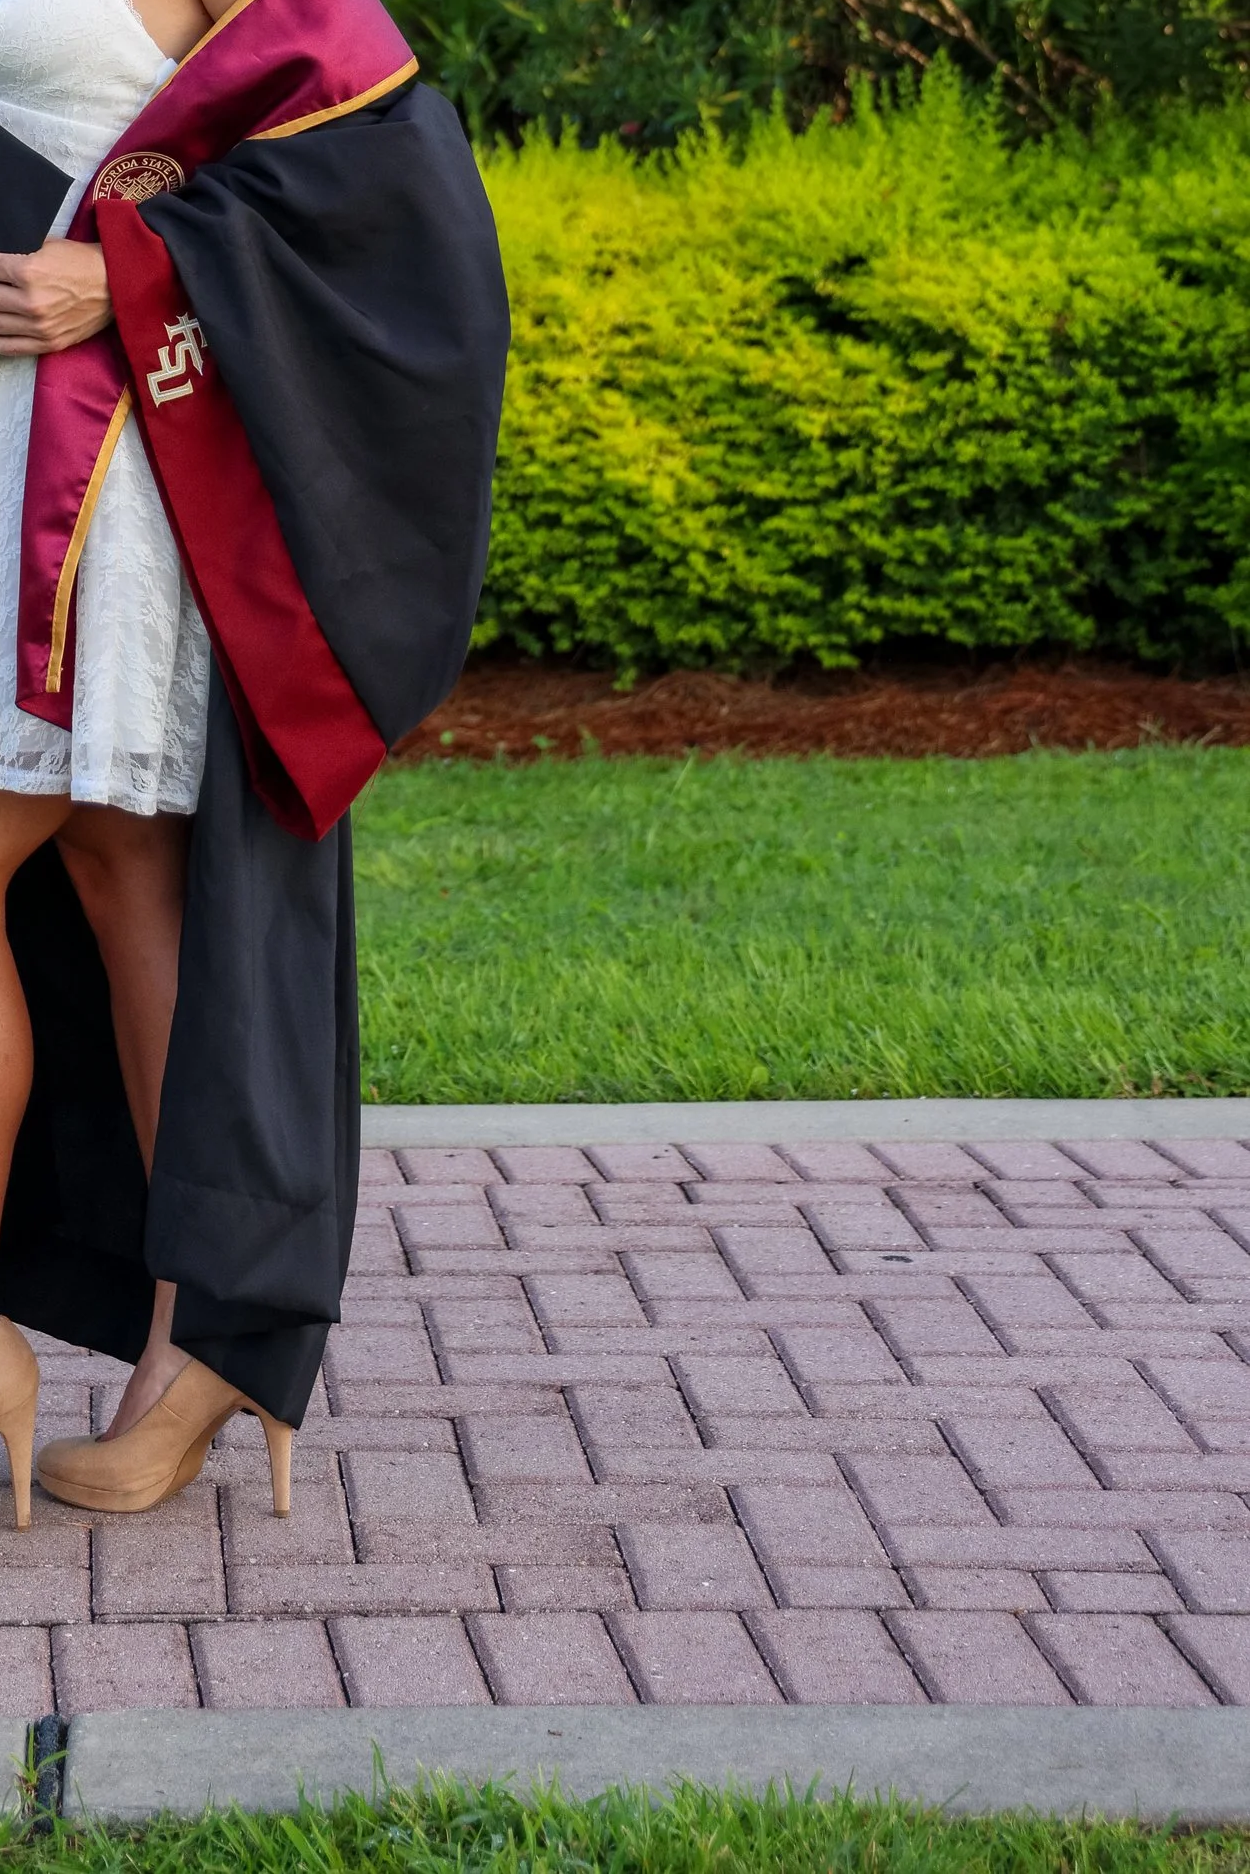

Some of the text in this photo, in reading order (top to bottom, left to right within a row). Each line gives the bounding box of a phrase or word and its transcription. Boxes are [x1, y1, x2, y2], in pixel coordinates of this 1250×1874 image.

[99, 159, 138, 198] FLORIDA
[142, 157, 173, 175] STATE
[146, 312, 208, 408] FSU
